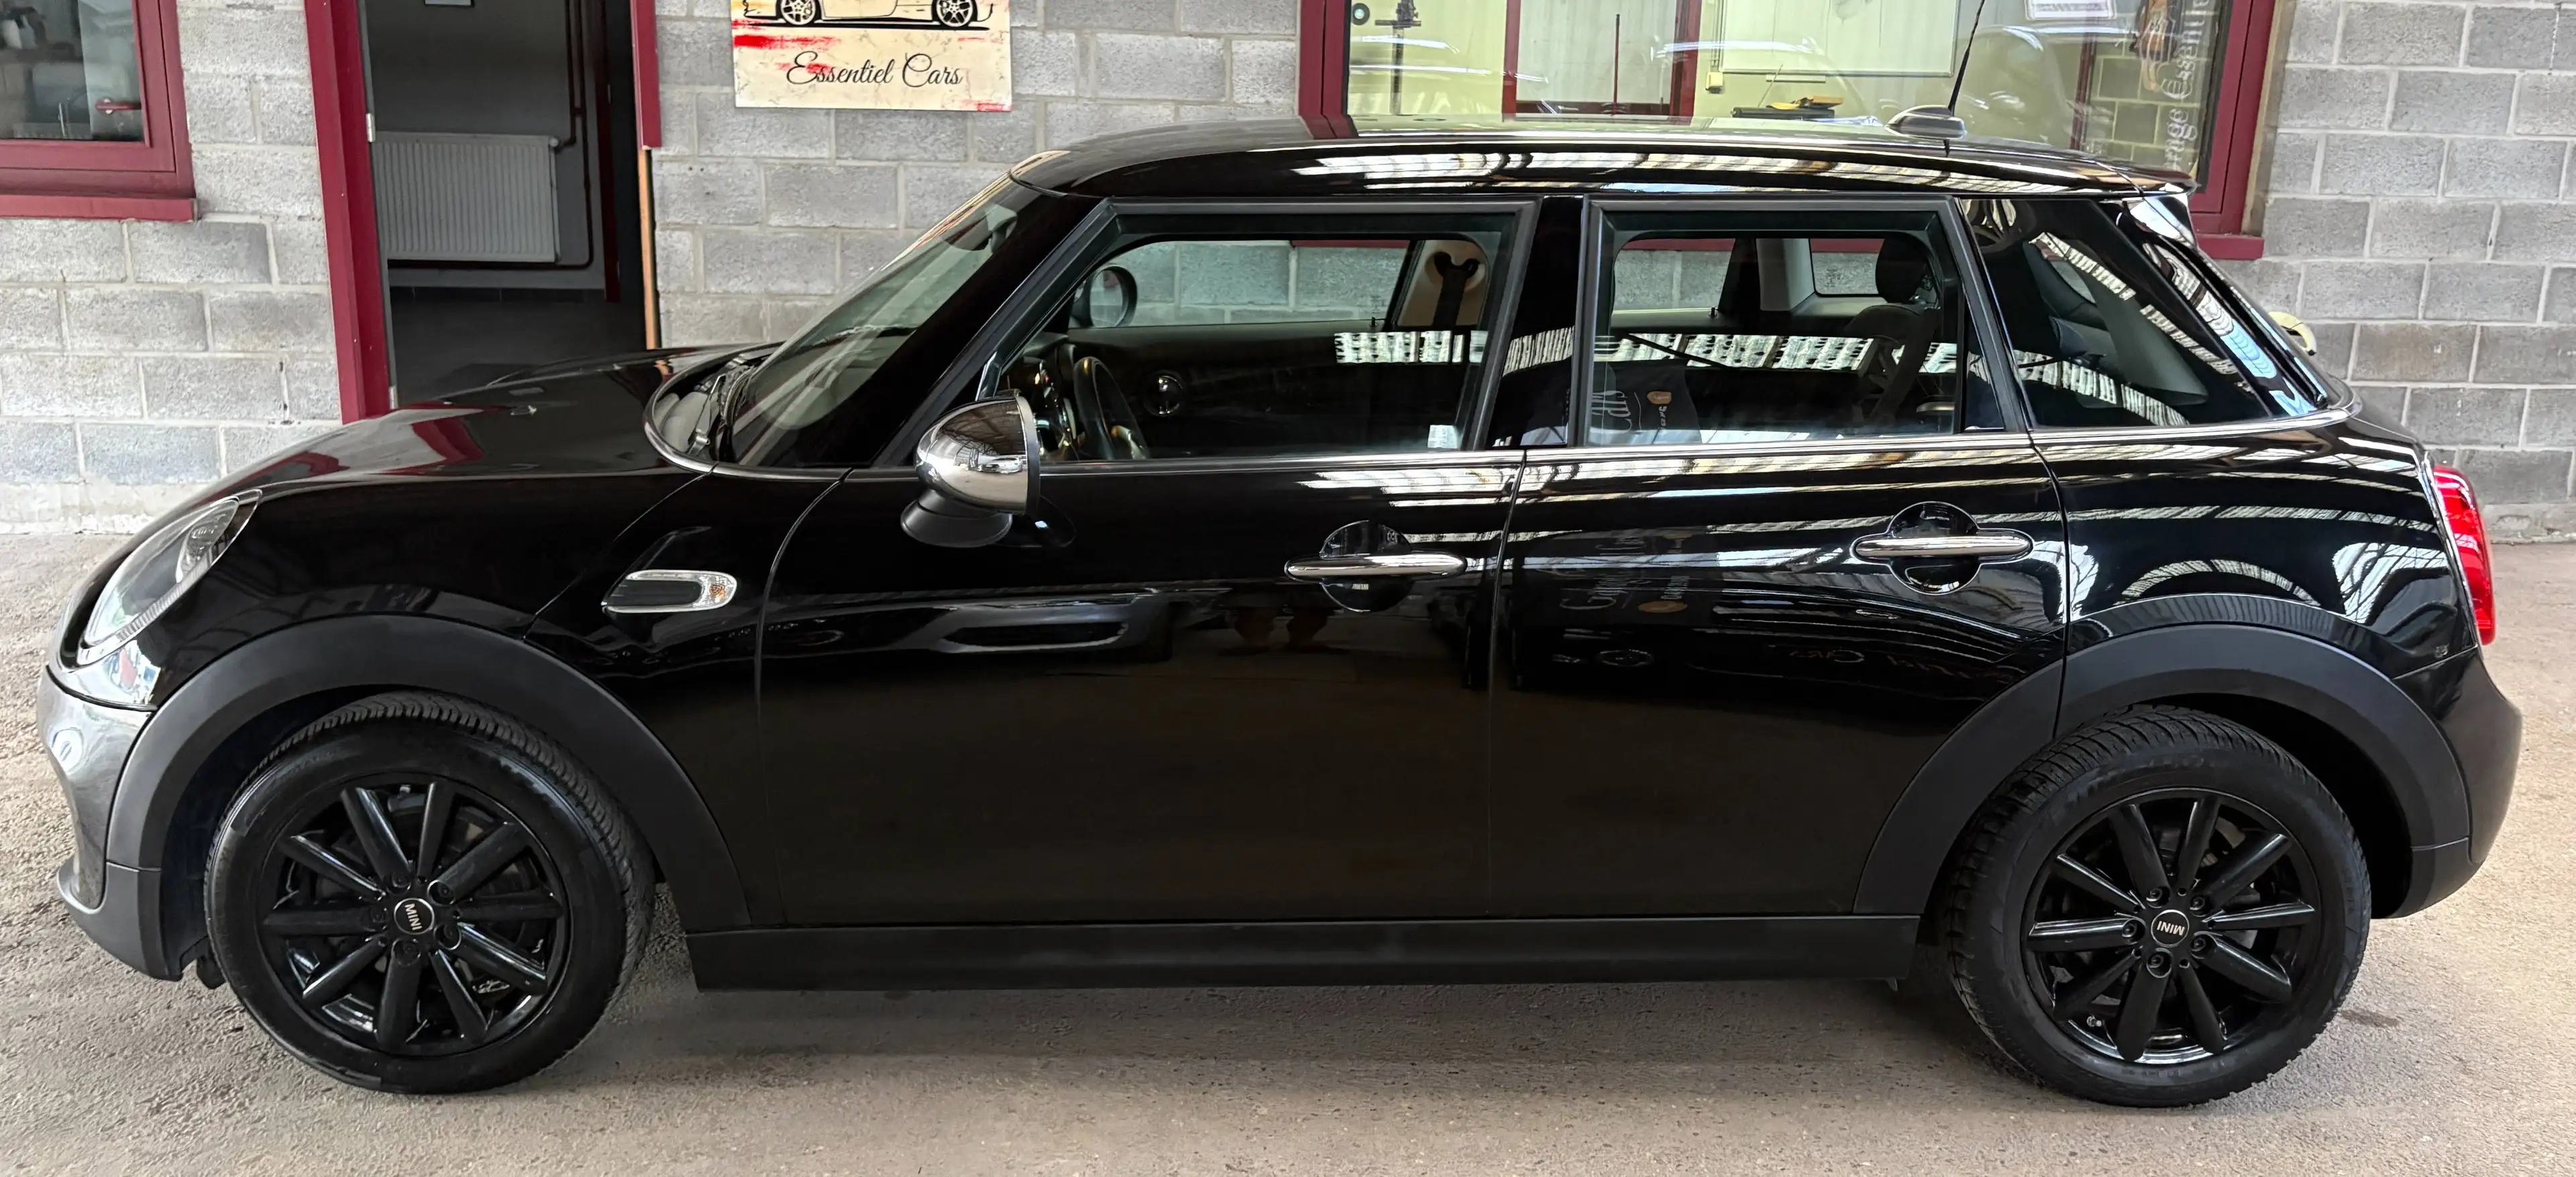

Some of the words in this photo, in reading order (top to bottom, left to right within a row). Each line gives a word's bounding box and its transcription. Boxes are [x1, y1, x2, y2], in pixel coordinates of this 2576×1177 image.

[786, 50, 895, 85] Essentiel
[902, 53, 963, 88] Cars
[405, 903, 423, 931] MINI
[2156, 921, 2185, 936] MINI
